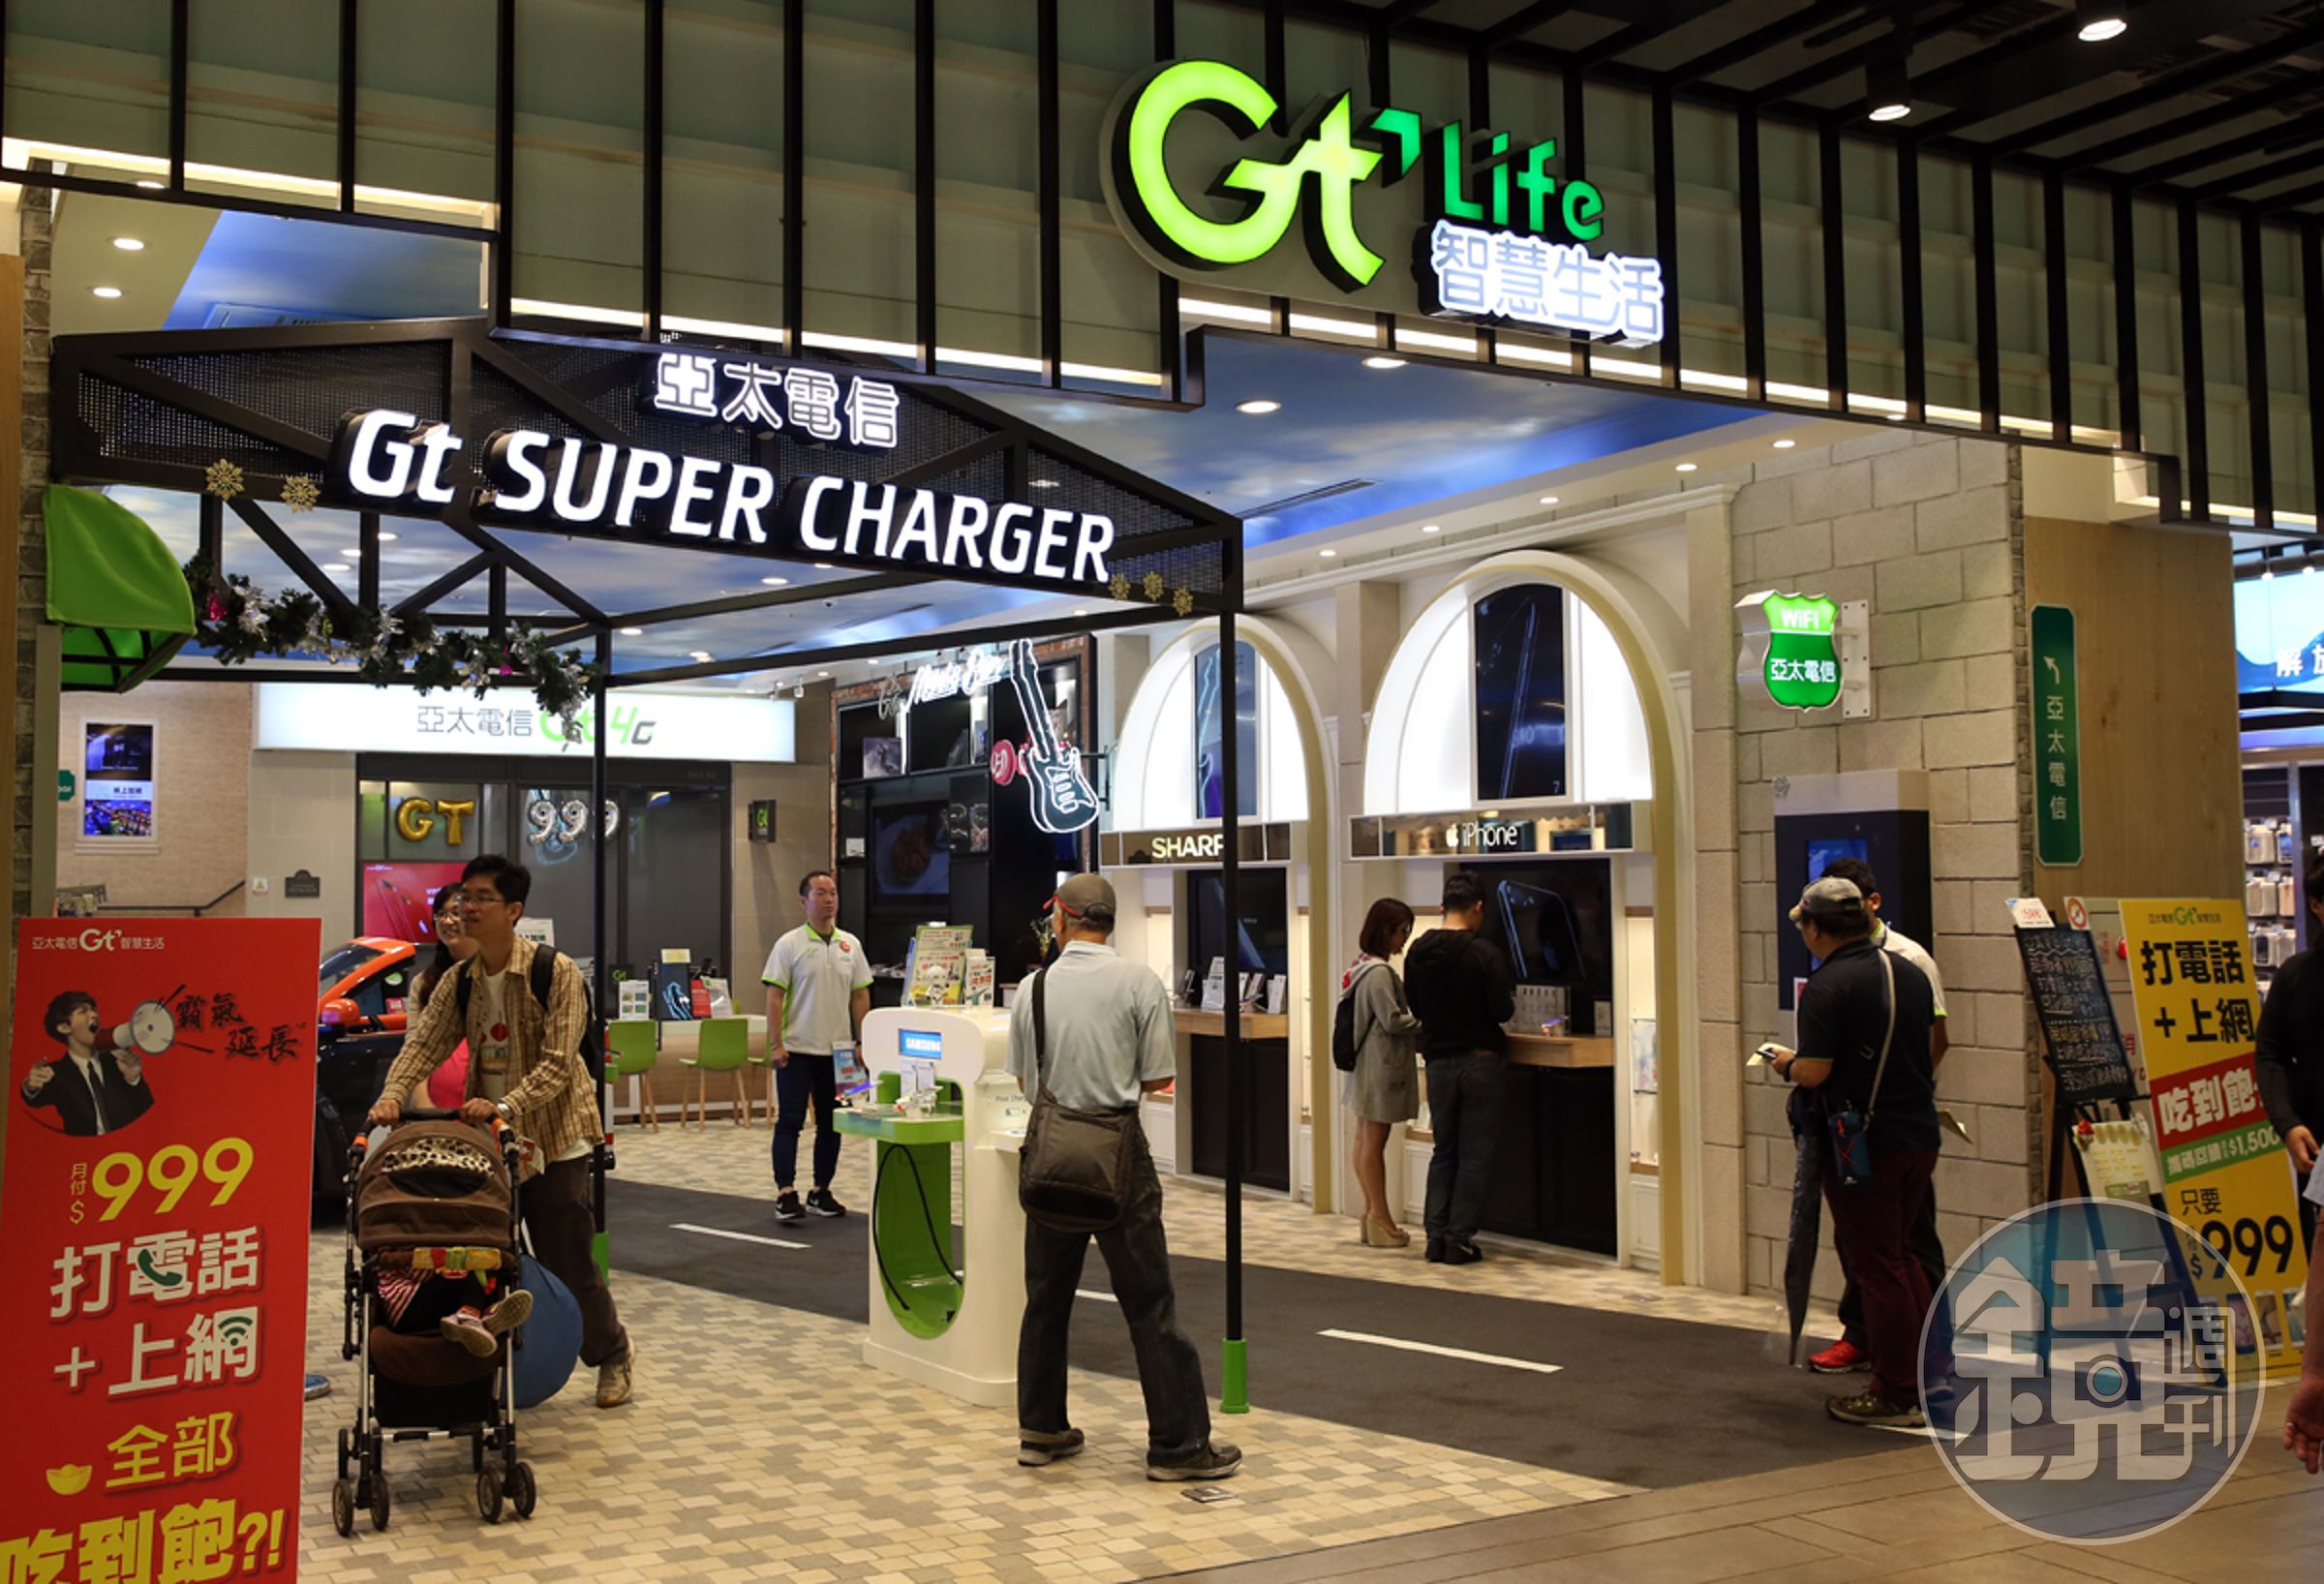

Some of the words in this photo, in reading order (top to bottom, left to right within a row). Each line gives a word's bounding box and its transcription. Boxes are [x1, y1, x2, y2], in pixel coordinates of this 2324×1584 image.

[1443, 121, 1604, 241] Life
[1430, 220, 1664, 342] 智慧生活
[655, 353, 900, 447] 亞太電信
[349, 410, 461, 503] Gt
[495, 429, 776, 543] SUPER
[799, 475, 1115, 582] CHARGER
[1781, 609, 1819, 629] WiFi
[1770, 659, 1836, 682] 亞太電信
[416, 706, 534, 737] 亞太電信
[2046, 695, 2067, 819] 亞太電信
[395, 797, 474, 845] GT
[1462, 822, 1518, 848] iPhone
[2141, 940, 2245, 987] 打電話
[2157, 1067, 2263, 1136] 吃到飽
[70, 1162, 88, 1198] 月付
[92, 1136, 255, 1223] 999
[2181, 1188, 2222, 1216] 只要
[50, 1226, 260, 1319] 打電話
[2201, 1215, 2294, 1279] 999
[106, 1410, 234, 1490] 全部
